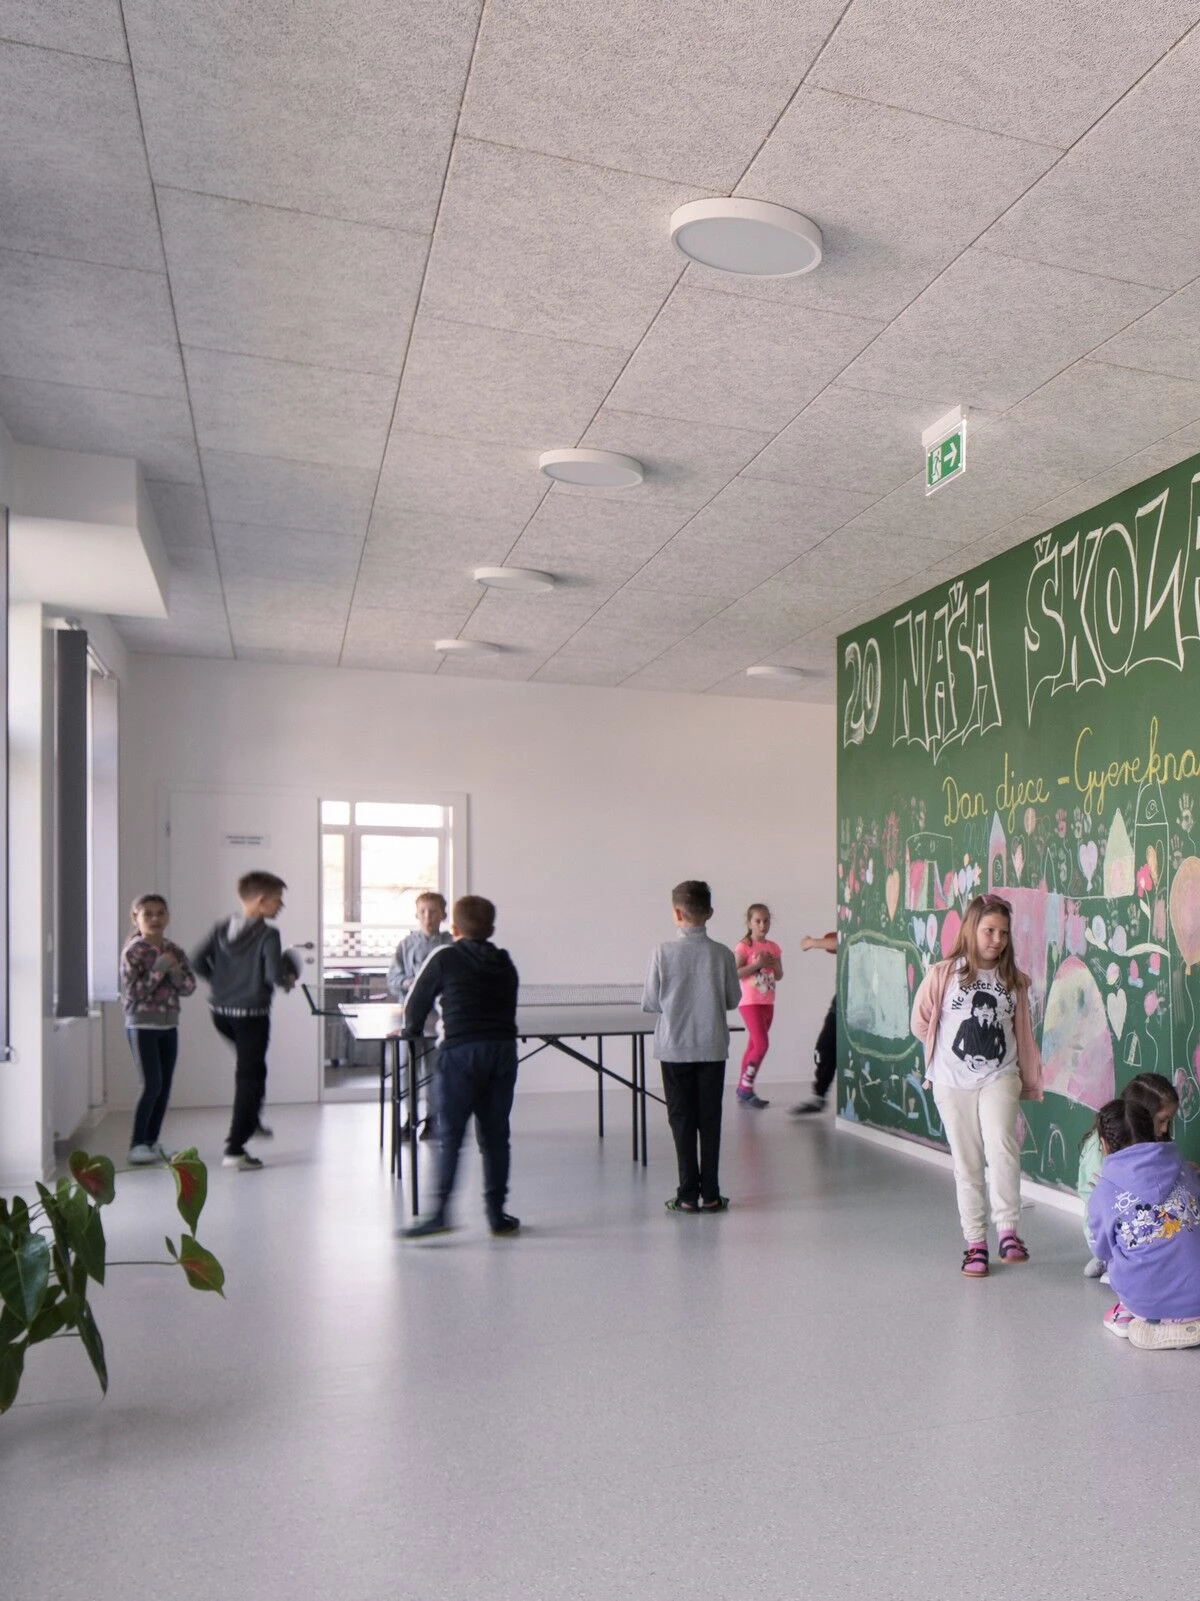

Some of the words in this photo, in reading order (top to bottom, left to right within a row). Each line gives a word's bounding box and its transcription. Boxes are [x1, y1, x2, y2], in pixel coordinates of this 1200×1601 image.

[844, 638, 882, 749] 20
[892, 580, 1002, 766] NAŠA
[942, 776, 988, 827] Dan
[995, 752, 1050, 834] djece
[951, 996, 964, 1010] We
[960, 980, 992, 995] Prefer
